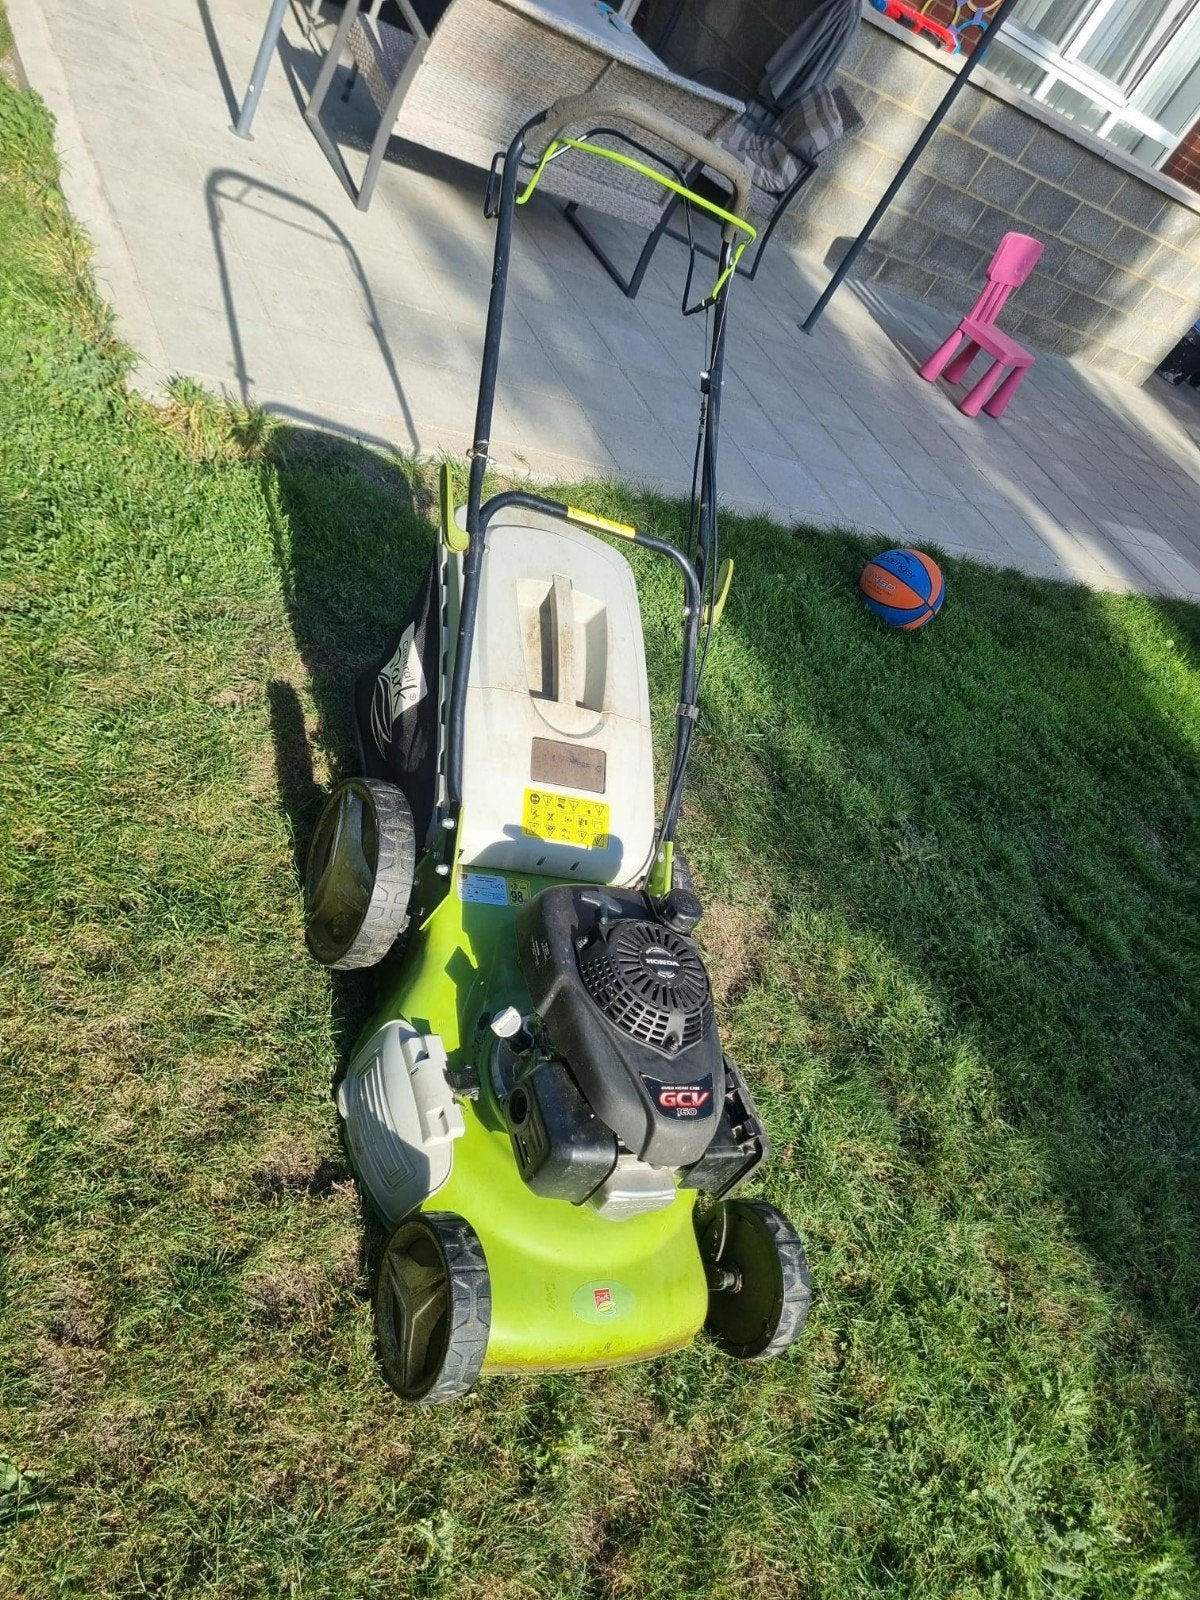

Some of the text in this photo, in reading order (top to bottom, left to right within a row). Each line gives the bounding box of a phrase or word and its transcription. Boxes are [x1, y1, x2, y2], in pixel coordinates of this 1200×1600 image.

[402, 640, 416, 682] Central
[511, 890, 524, 902] 98
[645, 958, 681, 966] HONDA
[659, 1091, 710, 1107] GCV
[676, 1107, 698, 1117] 160
